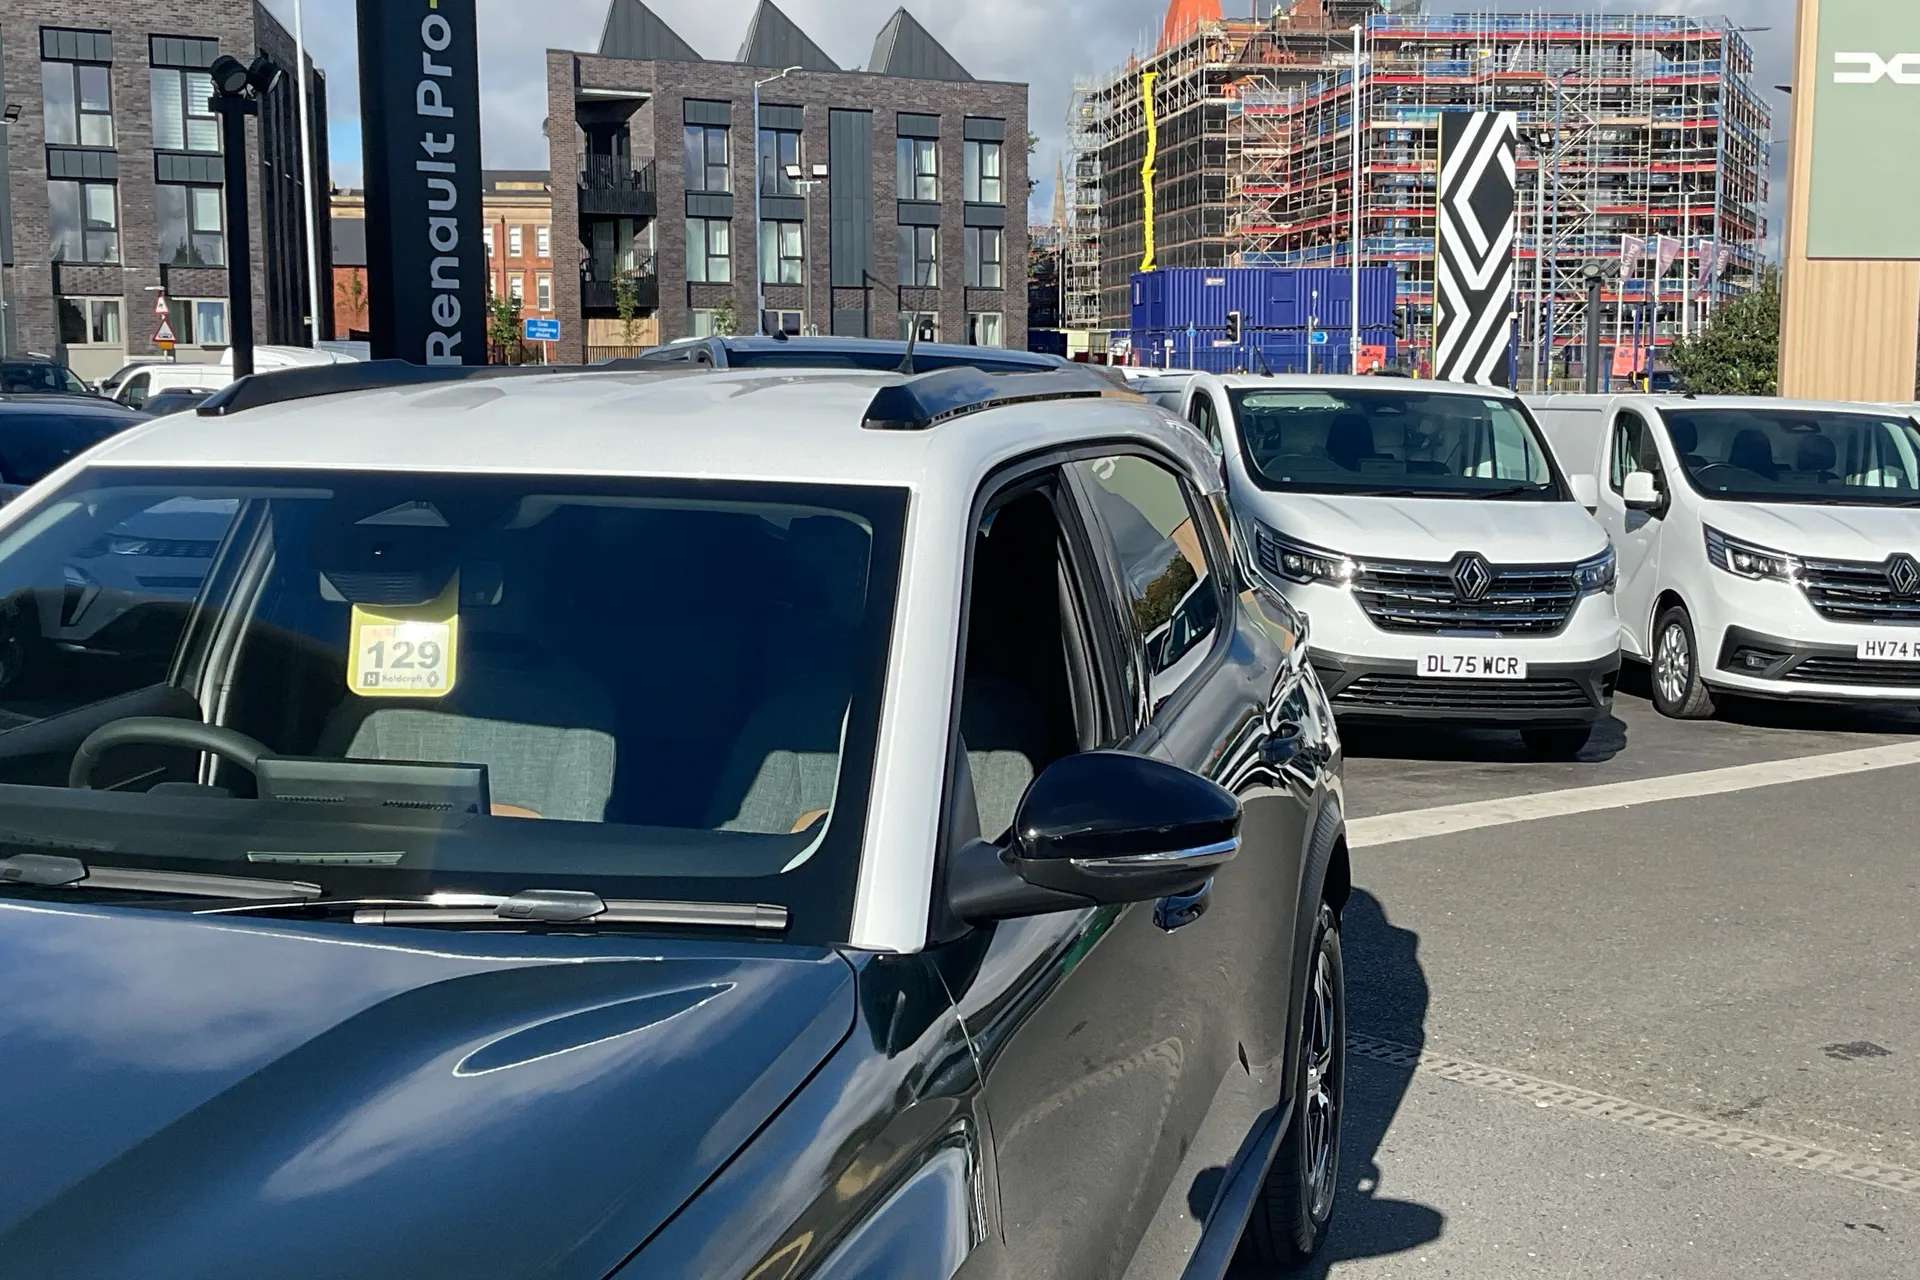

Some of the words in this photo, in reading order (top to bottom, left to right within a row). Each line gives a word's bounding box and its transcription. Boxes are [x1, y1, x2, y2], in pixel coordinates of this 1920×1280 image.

[416, 132, 463, 366] Renault
[367, 640, 441, 669] 129
[1865, 640, 1909, 657] HV74
[1427, 655, 1477, 674] DL75
[1483, 656, 1519, 675] WCR
